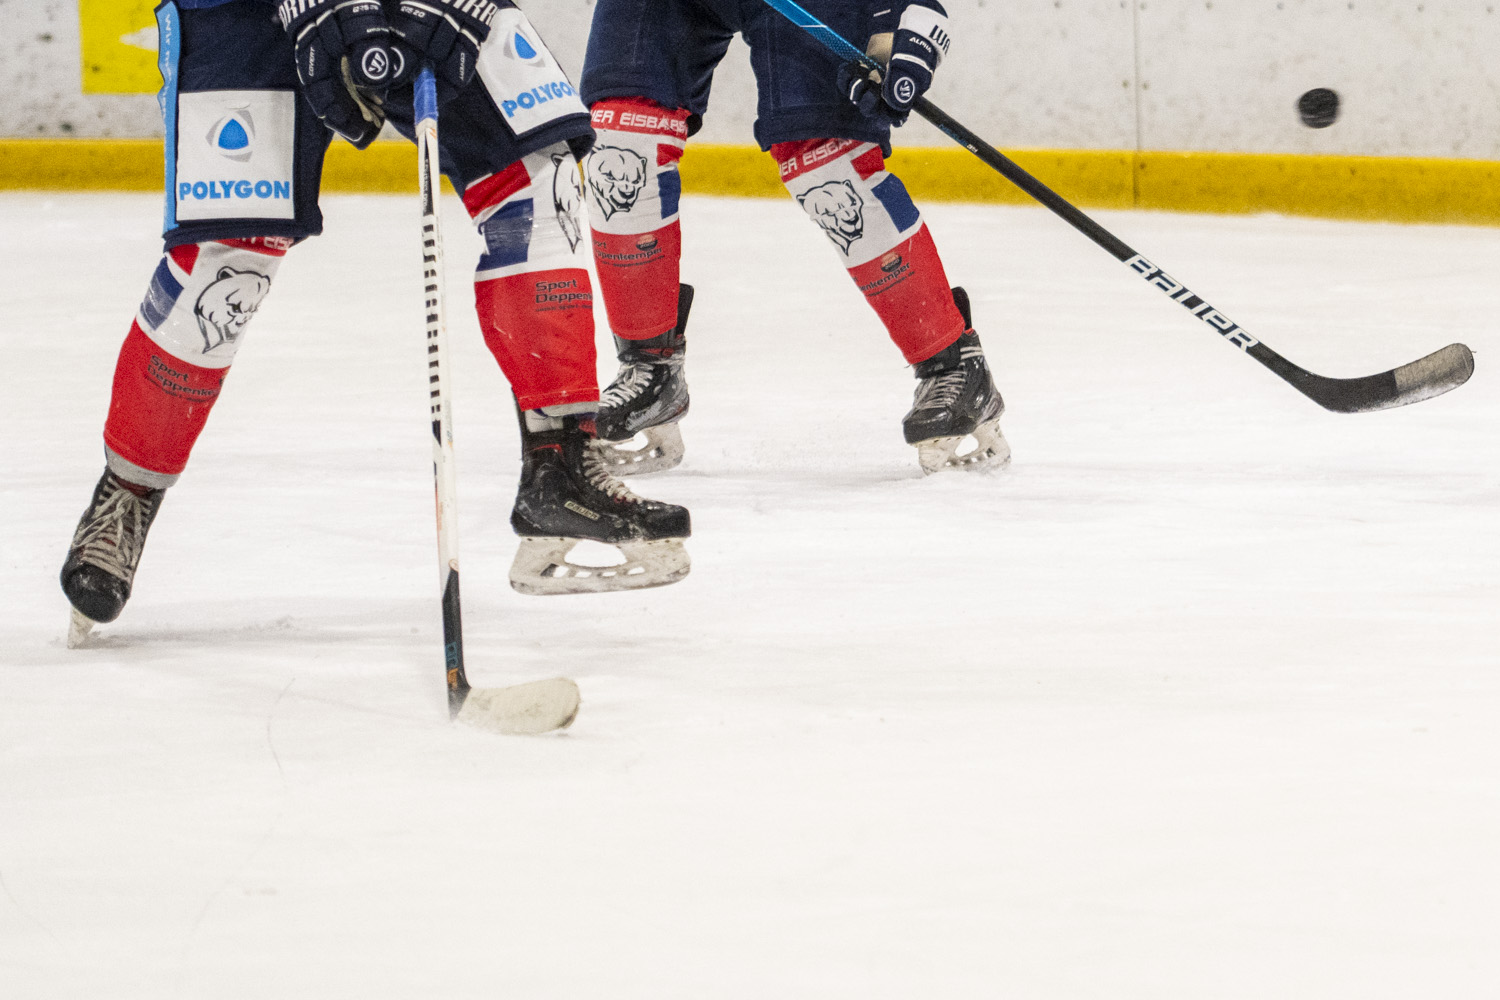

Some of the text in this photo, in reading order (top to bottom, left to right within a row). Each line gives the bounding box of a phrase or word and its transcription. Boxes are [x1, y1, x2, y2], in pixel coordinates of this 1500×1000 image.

[909, 36, 932, 54] ALPHA
[179, 179, 290, 201] POLYGON
[536, 279, 577, 293] Sport
[150, 355, 189, 382] Sport
